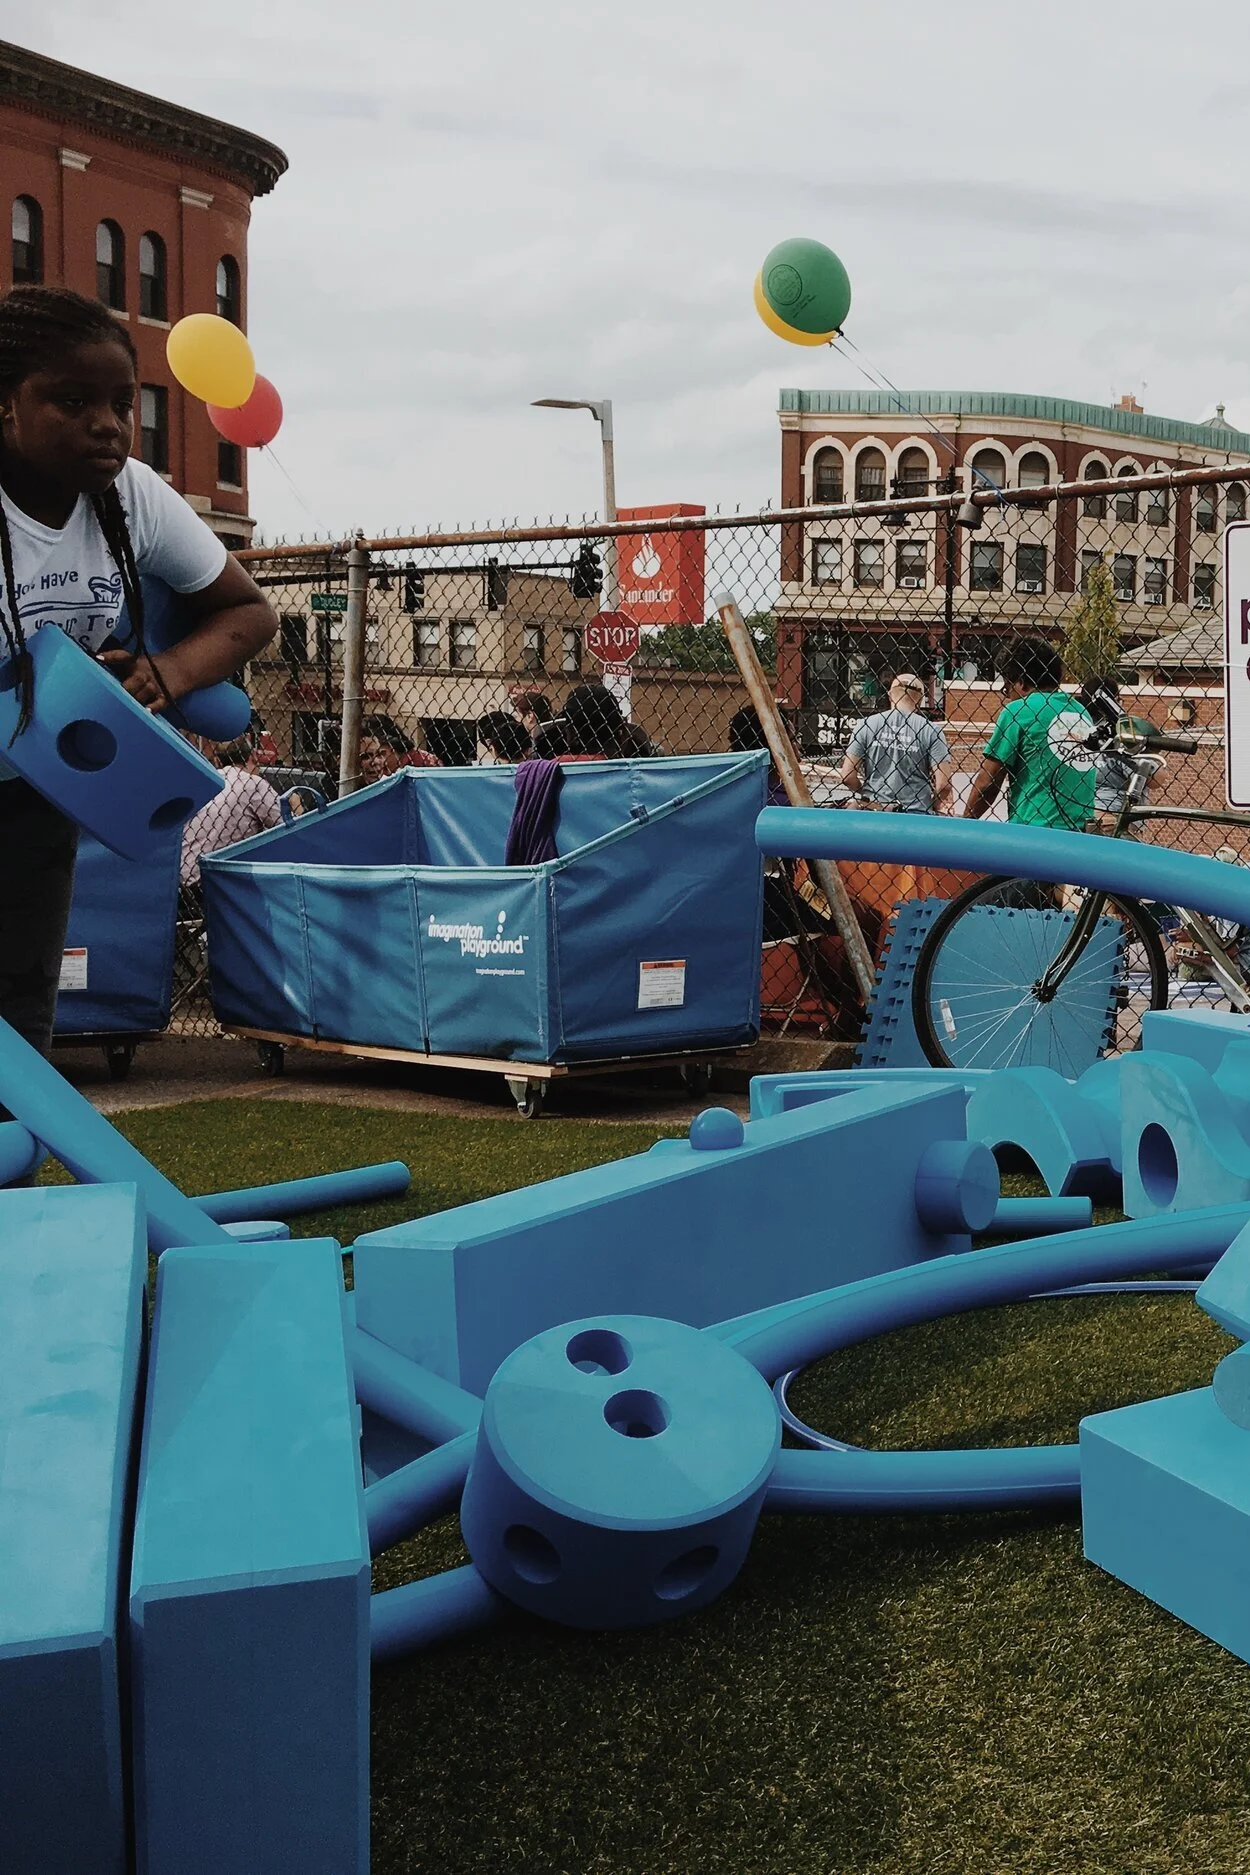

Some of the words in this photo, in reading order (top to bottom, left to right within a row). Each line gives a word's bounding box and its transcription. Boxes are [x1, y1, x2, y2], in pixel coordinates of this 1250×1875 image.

[40, 570, 79, 590] Have
[589, 627, 636, 647] STOP
[428, 914, 484, 942] imagination
